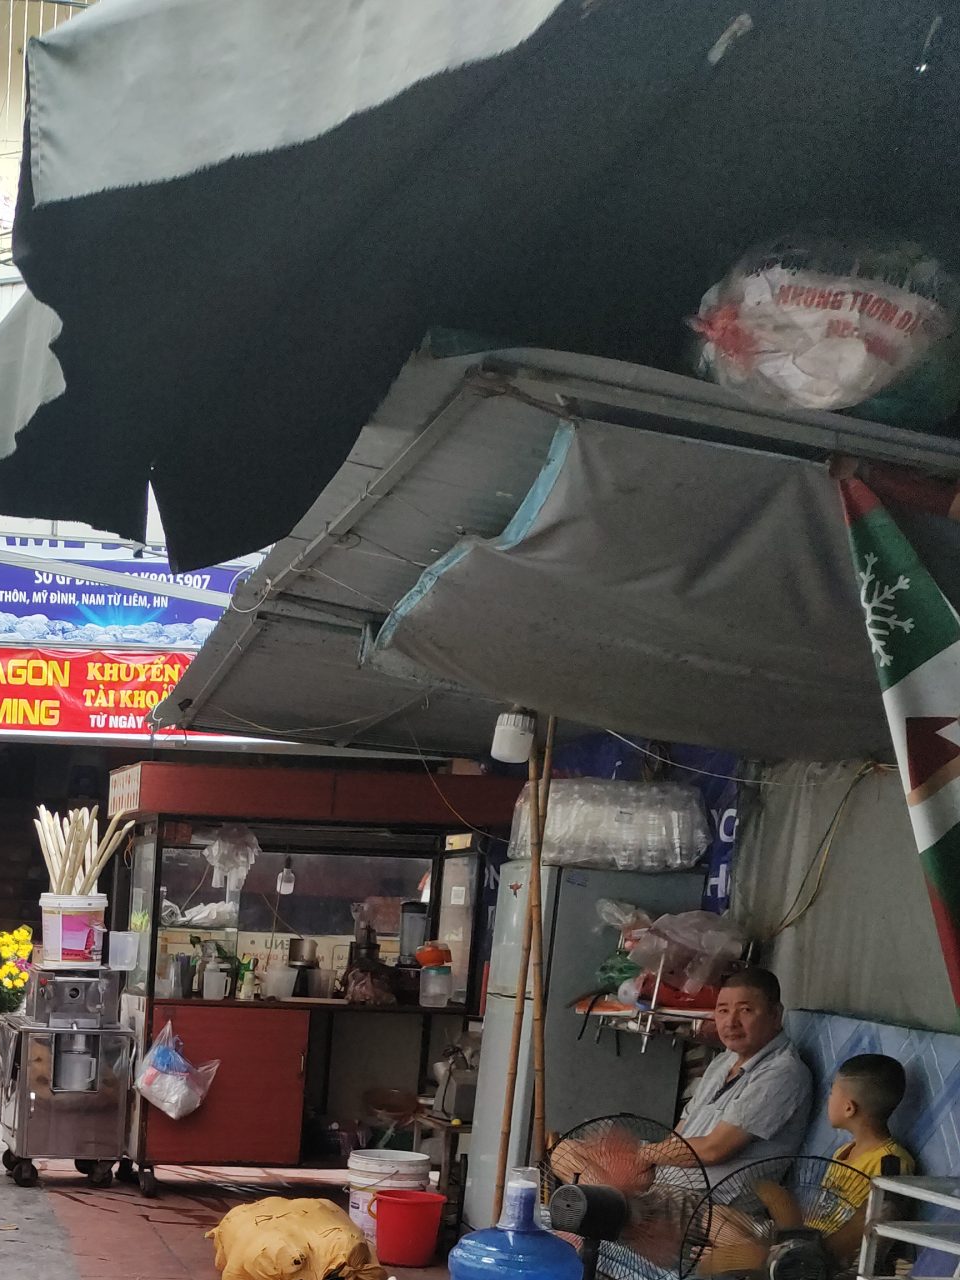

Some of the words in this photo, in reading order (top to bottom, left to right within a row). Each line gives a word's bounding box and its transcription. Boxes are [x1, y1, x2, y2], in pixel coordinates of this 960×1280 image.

[32, 589, 49, 604] MỸ
[49, 590, 80, 606] ĐÌNH,
[81, 593, 106, 606] NAM
[107, 592, 122, 606] TỪ
[123, 592, 151, 609] LIÊM,
[153, 596, 169, 608] HN
[83, 684, 116, 708] TÀI
[119, 683, 170, 709] KHOẢ
[89, 711, 107, 728] TỪ
[108, 712, 144, 729] NGÀY
